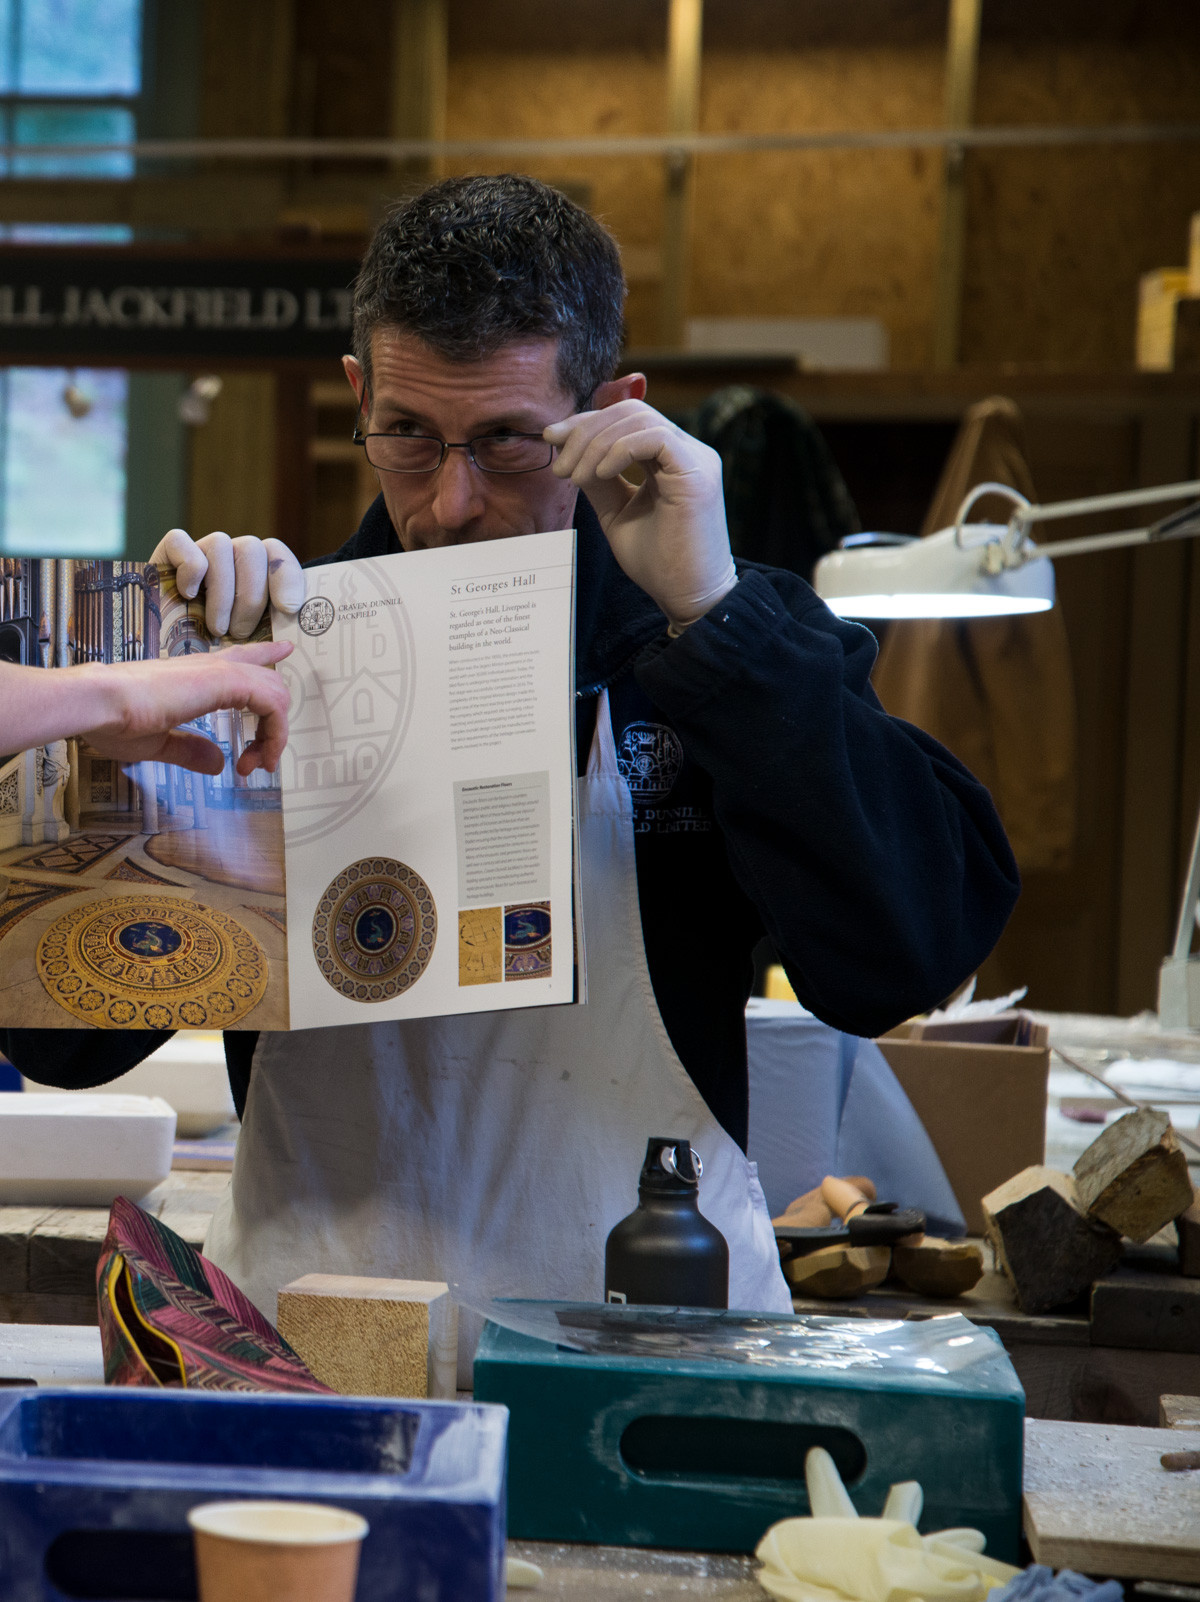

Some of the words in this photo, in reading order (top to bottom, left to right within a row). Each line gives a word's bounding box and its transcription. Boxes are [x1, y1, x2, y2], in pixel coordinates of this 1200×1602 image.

[61, 284, 299, 329] JACKFIELD
[305, 286, 356, 329] LT
[450, 584, 461, 595] St
[465, 582, 508, 593] Georges
[512, 574, 536, 587] Hall
[338, 602, 367, 612] CRAVEN
[369, 598, 403, 609] DUNNILL
[502, 602, 530, 613] Liverpool
[338, 610, 377, 621] JACKFIELD
[449, 619, 475, 631] regarded
[495, 616, 503, 624] of
[503, 615, 513, 623] the
[514, 613, 531, 622] finest
[449, 629, 476, 641] examples
[476, 628, 484, 637] of
[489, 624, 530, 636] Neo-Classical
[449, 641, 474, 652] building
[474, 640, 482, 648] in
[482, 638, 492, 648] the
